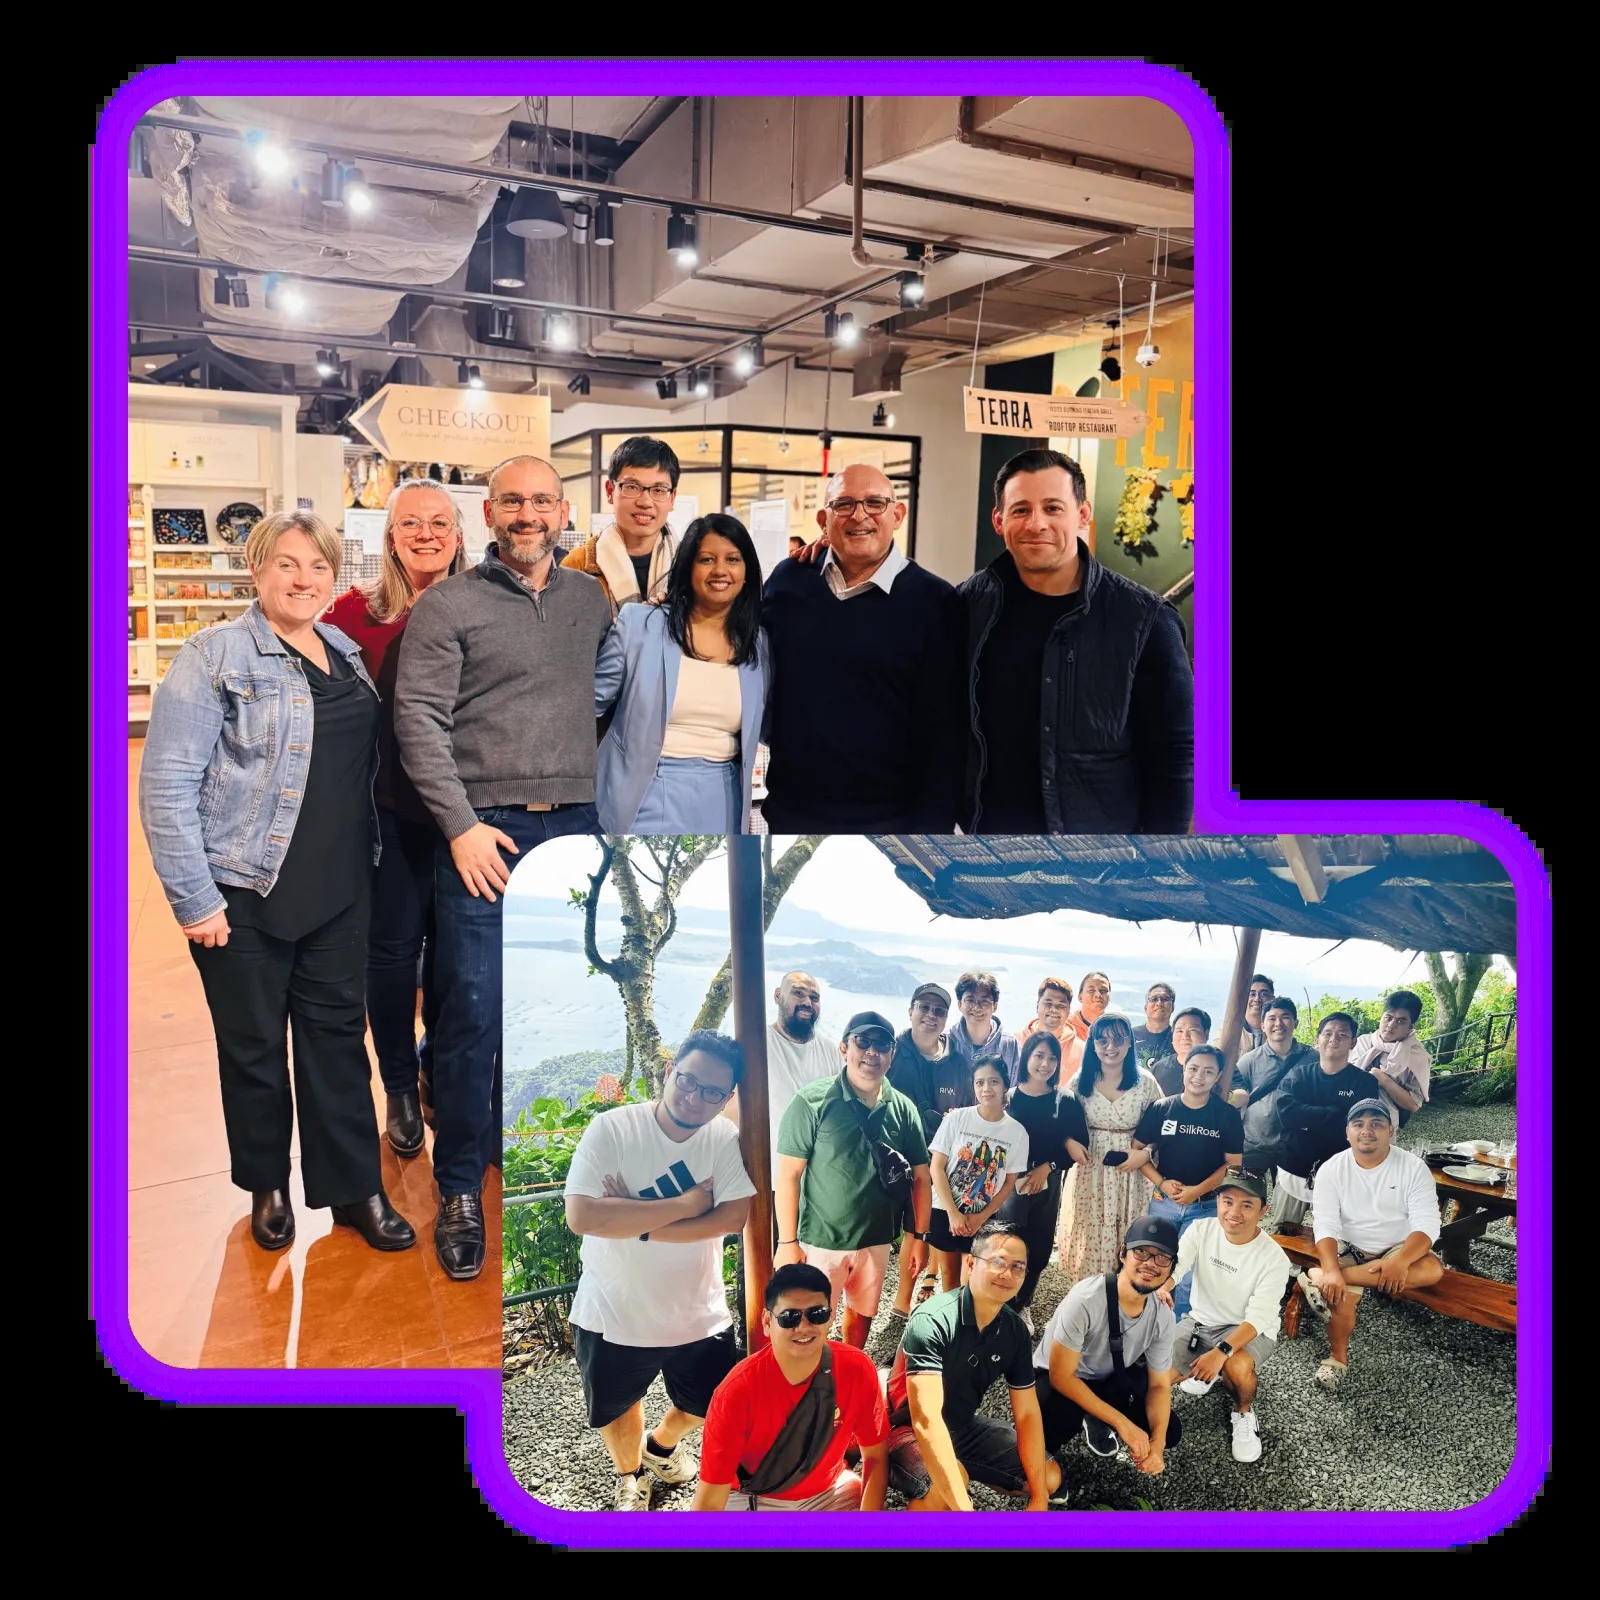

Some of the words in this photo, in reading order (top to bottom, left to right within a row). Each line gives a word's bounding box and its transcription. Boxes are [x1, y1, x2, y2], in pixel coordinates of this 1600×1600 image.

[397, 406, 537, 433] CHECKOUT
[977, 396, 1033, 430] TERRA
[1048, 421, 1076, 432] ROOFTOP
[1078, 422, 1117, 433] RESTAURANT
